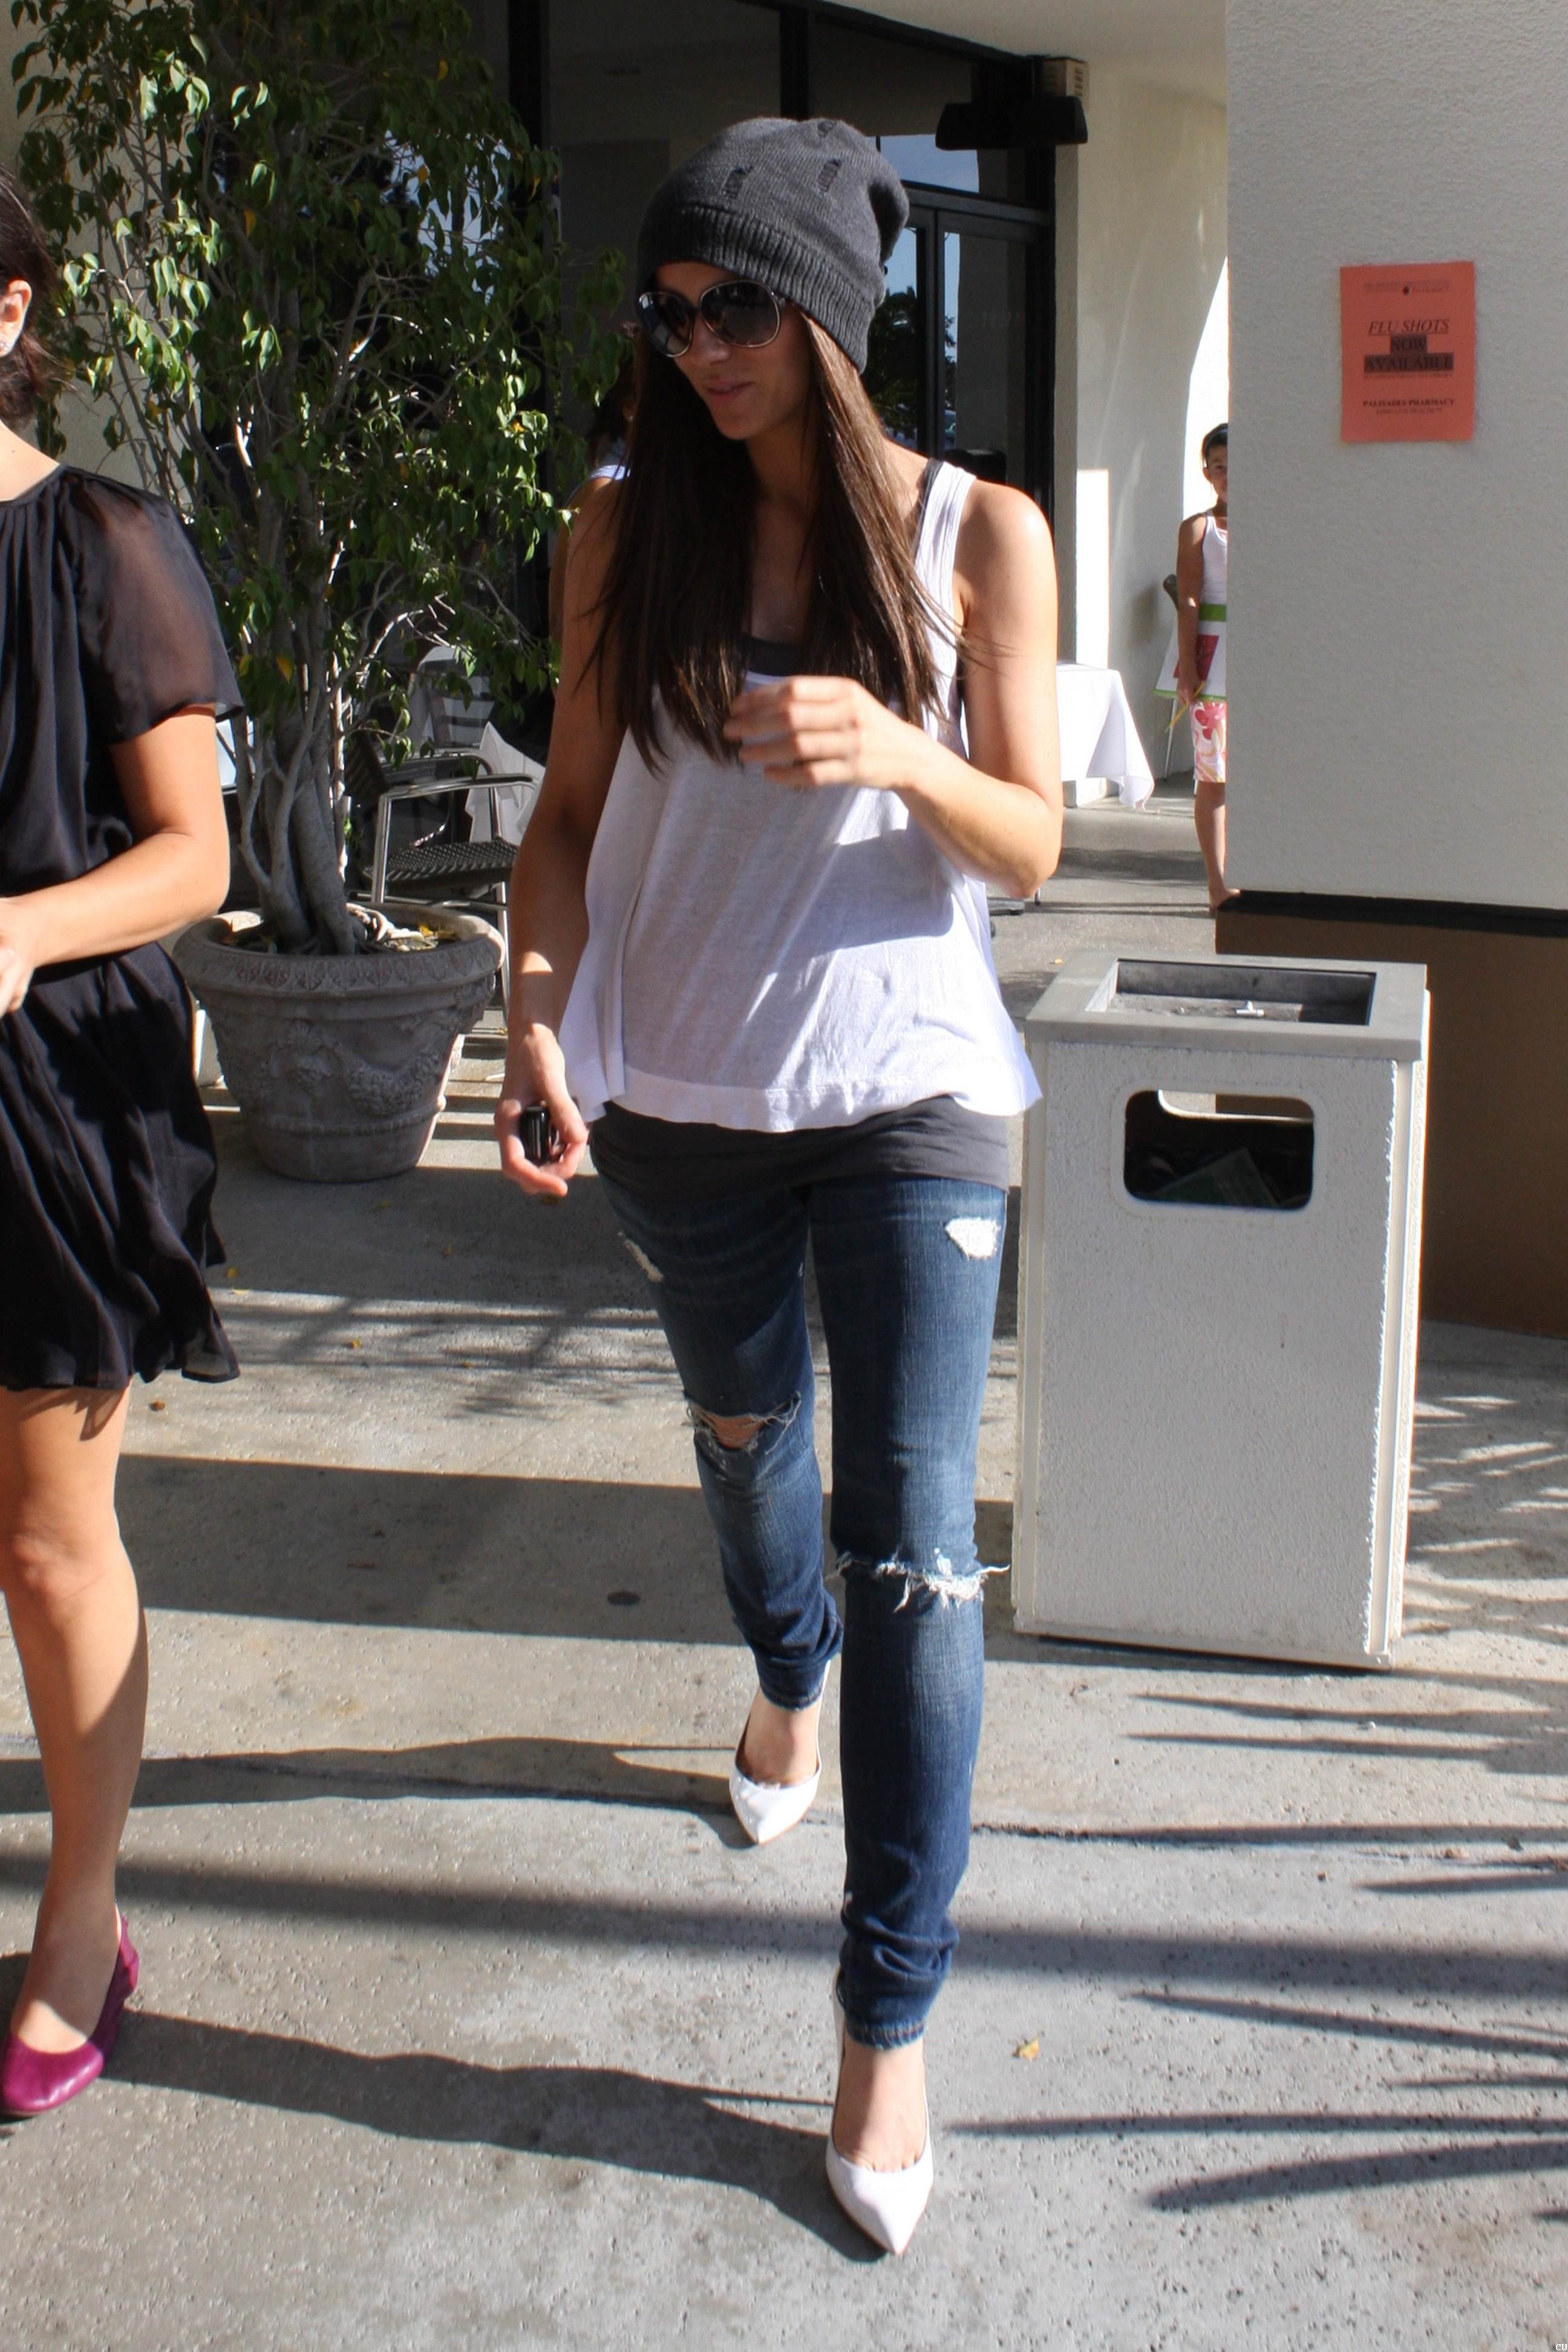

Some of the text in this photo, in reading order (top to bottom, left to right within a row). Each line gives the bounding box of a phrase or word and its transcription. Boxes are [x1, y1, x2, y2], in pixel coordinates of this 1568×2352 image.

[1368, 319, 1449, 334] FLU SHOTS
[1392, 337, 1426, 350] NOW
[1365, 355, 1453, 370] AVAILABLE
